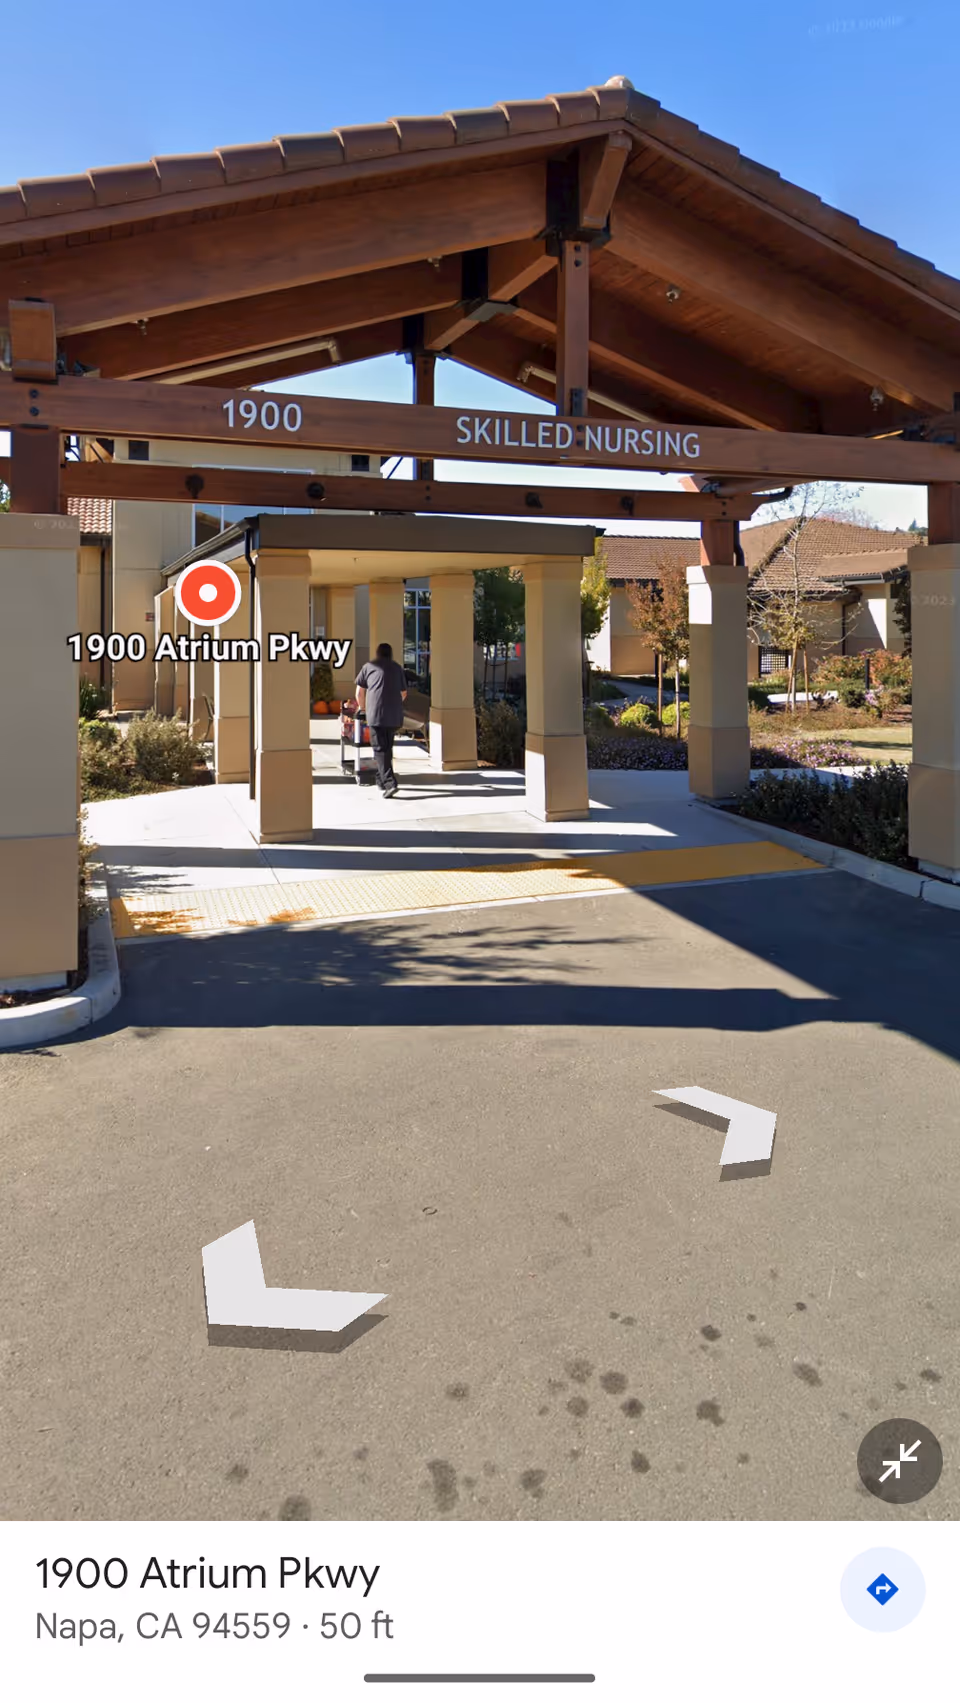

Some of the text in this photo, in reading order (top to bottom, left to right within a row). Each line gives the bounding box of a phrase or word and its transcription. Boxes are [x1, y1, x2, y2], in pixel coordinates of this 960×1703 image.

[223, 399, 302, 432] 1900
[456, 416, 701, 458] SKILLED NURSING
